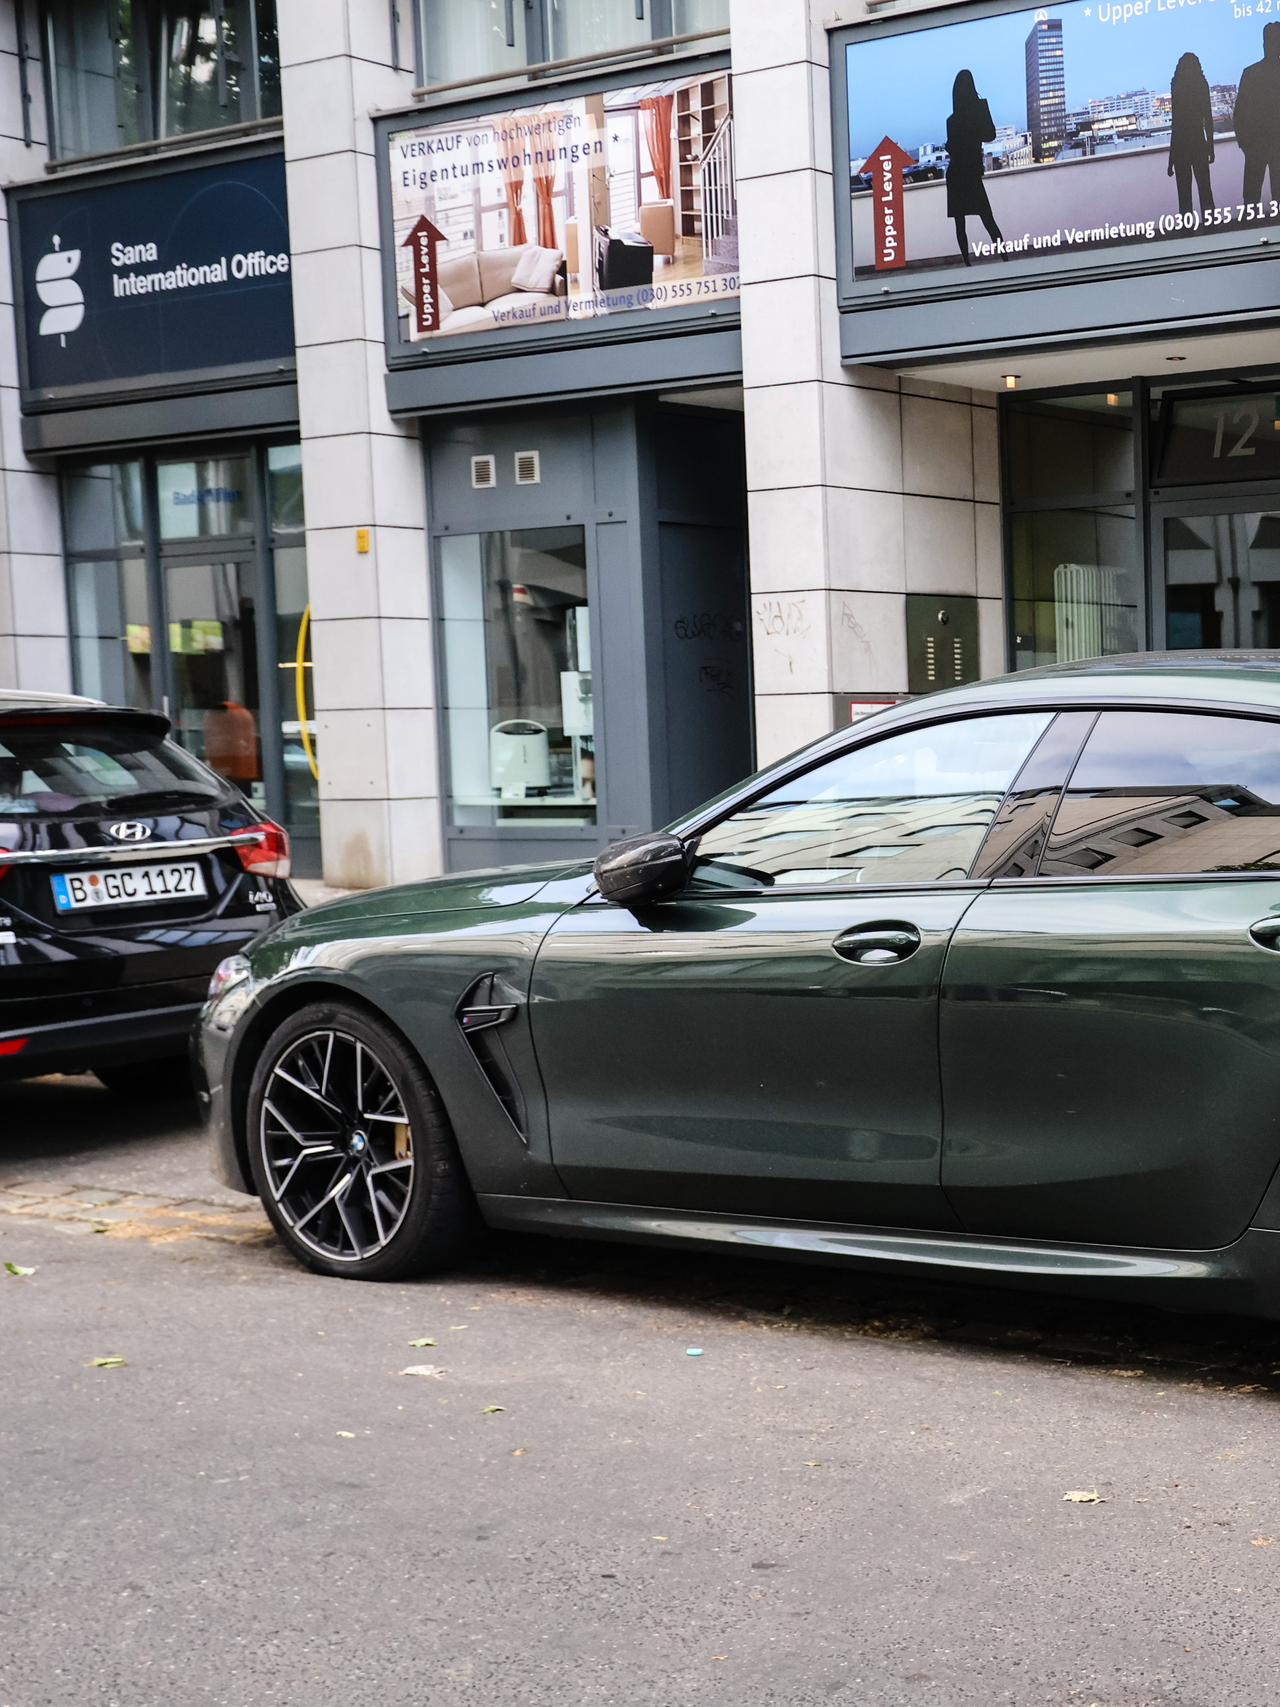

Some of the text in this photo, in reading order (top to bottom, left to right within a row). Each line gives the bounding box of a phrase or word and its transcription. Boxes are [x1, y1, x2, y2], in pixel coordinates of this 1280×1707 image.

[1098, 0, 1152, 25] Upper
[1233, 3, 1252, 19] bis
[1256, 0, 1272, 13] 42
[400, 115, 581, 159] VERKAUF von hochwertigen
[402, 139, 603, 190] Eigentumswohnungen
[879, 155, 898, 262] Upper Level
[971, 233, 1030, 257] Verkauf
[1032, 229, 1061, 250] und
[1064, 218, 1156, 246] Vermietung
[1158, 210, 1200, 236] (030)
[1204, 206, 1232, 227] 555
[1236, 202, 1266, 222] 751
[111, 241, 158, 267] Sana
[112, 250, 290, 298] International Office
[416, 231, 435, 326] Upper Level
[492, 302, 537, 323] Verkauf
[540, 299, 561, 317] und
[563, 291, 634, 313] Vermietung
[636, 284, 669, 306] (030)
[671, 281, 693, 299] 555
[696, 279, 718, 295] 751
[1212, 407, 1260, 458] 12
[69, 867, 196, 903] B GC 1127
